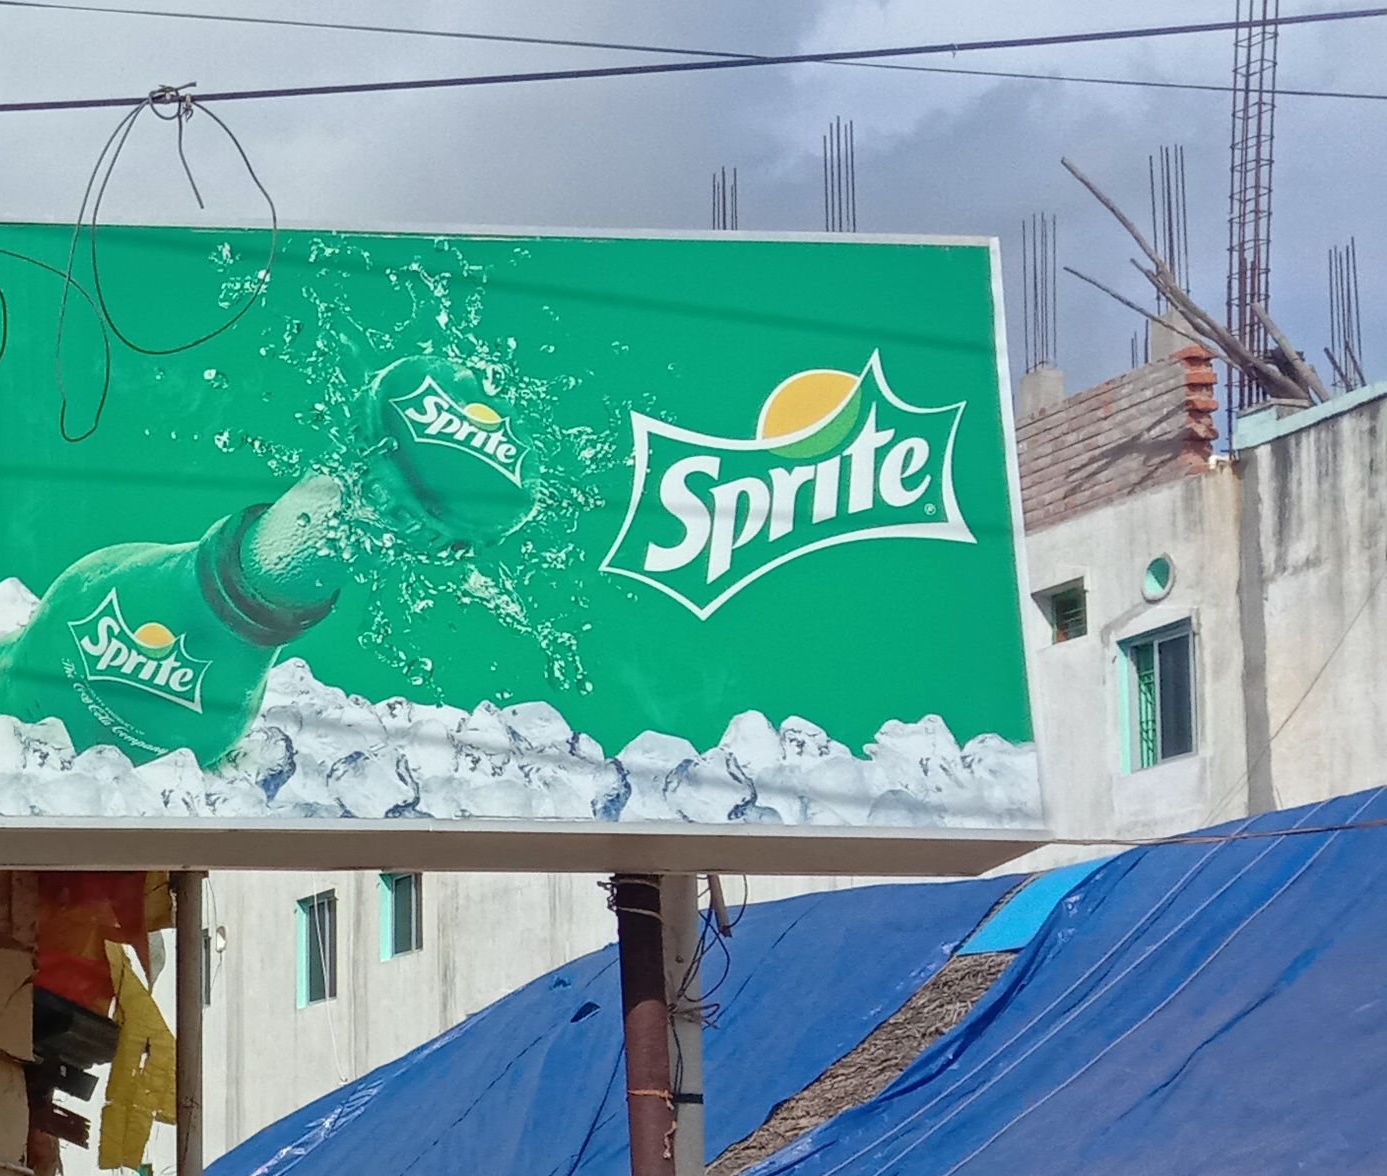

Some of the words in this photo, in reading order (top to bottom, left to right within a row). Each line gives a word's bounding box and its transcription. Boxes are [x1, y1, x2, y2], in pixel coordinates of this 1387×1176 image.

[404, 394, 518, 465] Sprite
[644, 403, 932, 584] Sprite
[81, 616, 195, 693] Sprite
